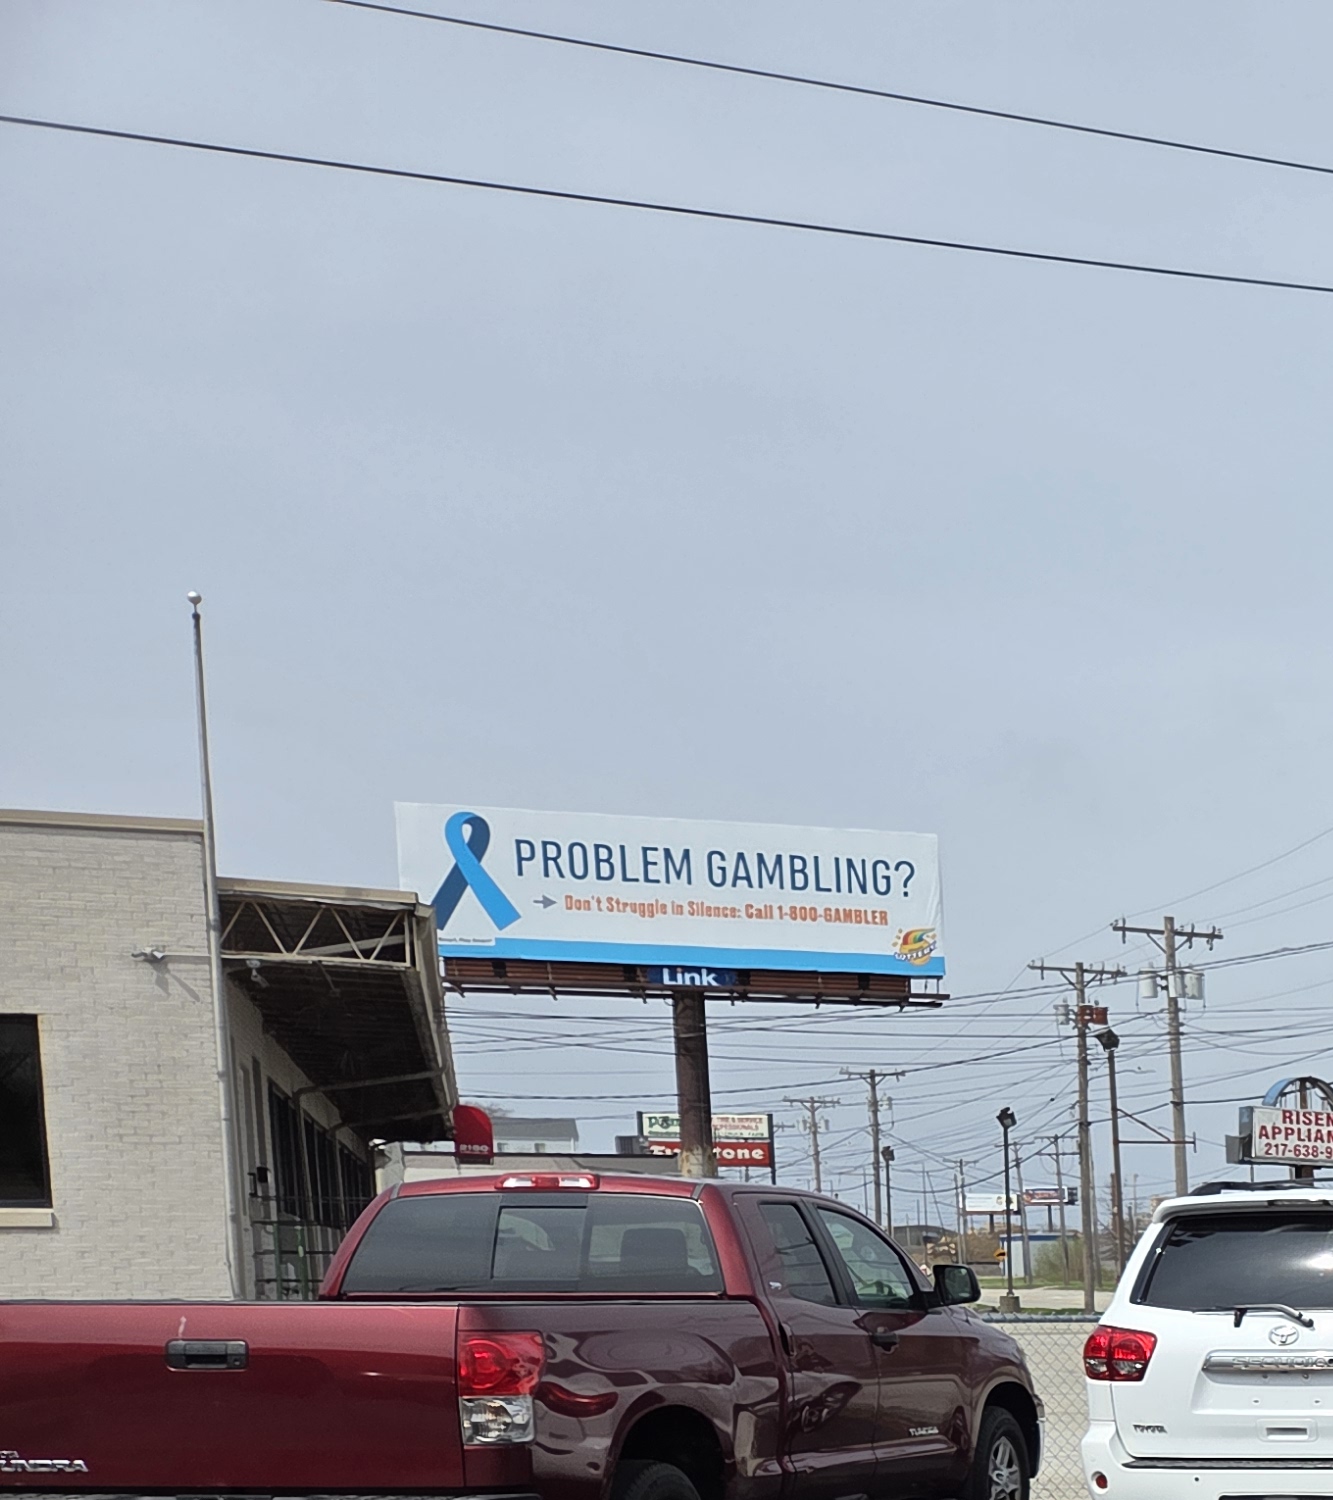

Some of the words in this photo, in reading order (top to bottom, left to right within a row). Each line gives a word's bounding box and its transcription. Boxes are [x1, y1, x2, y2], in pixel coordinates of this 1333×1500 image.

[515, 838, 692, 886] PROBLEM
[706, 850, 915, 897] GAMBLING?
[564, 894, 603, 912] Don't
[606, 896, 668, 918] Struggle
[671, 900, 684, 915] in
[687, 900, 742, 919] Silence:
[744, 903, 774, 920] Call
[777, 905, 888, 926] 1-800-GAMBLER
[662, 967, 720, 987] Link
